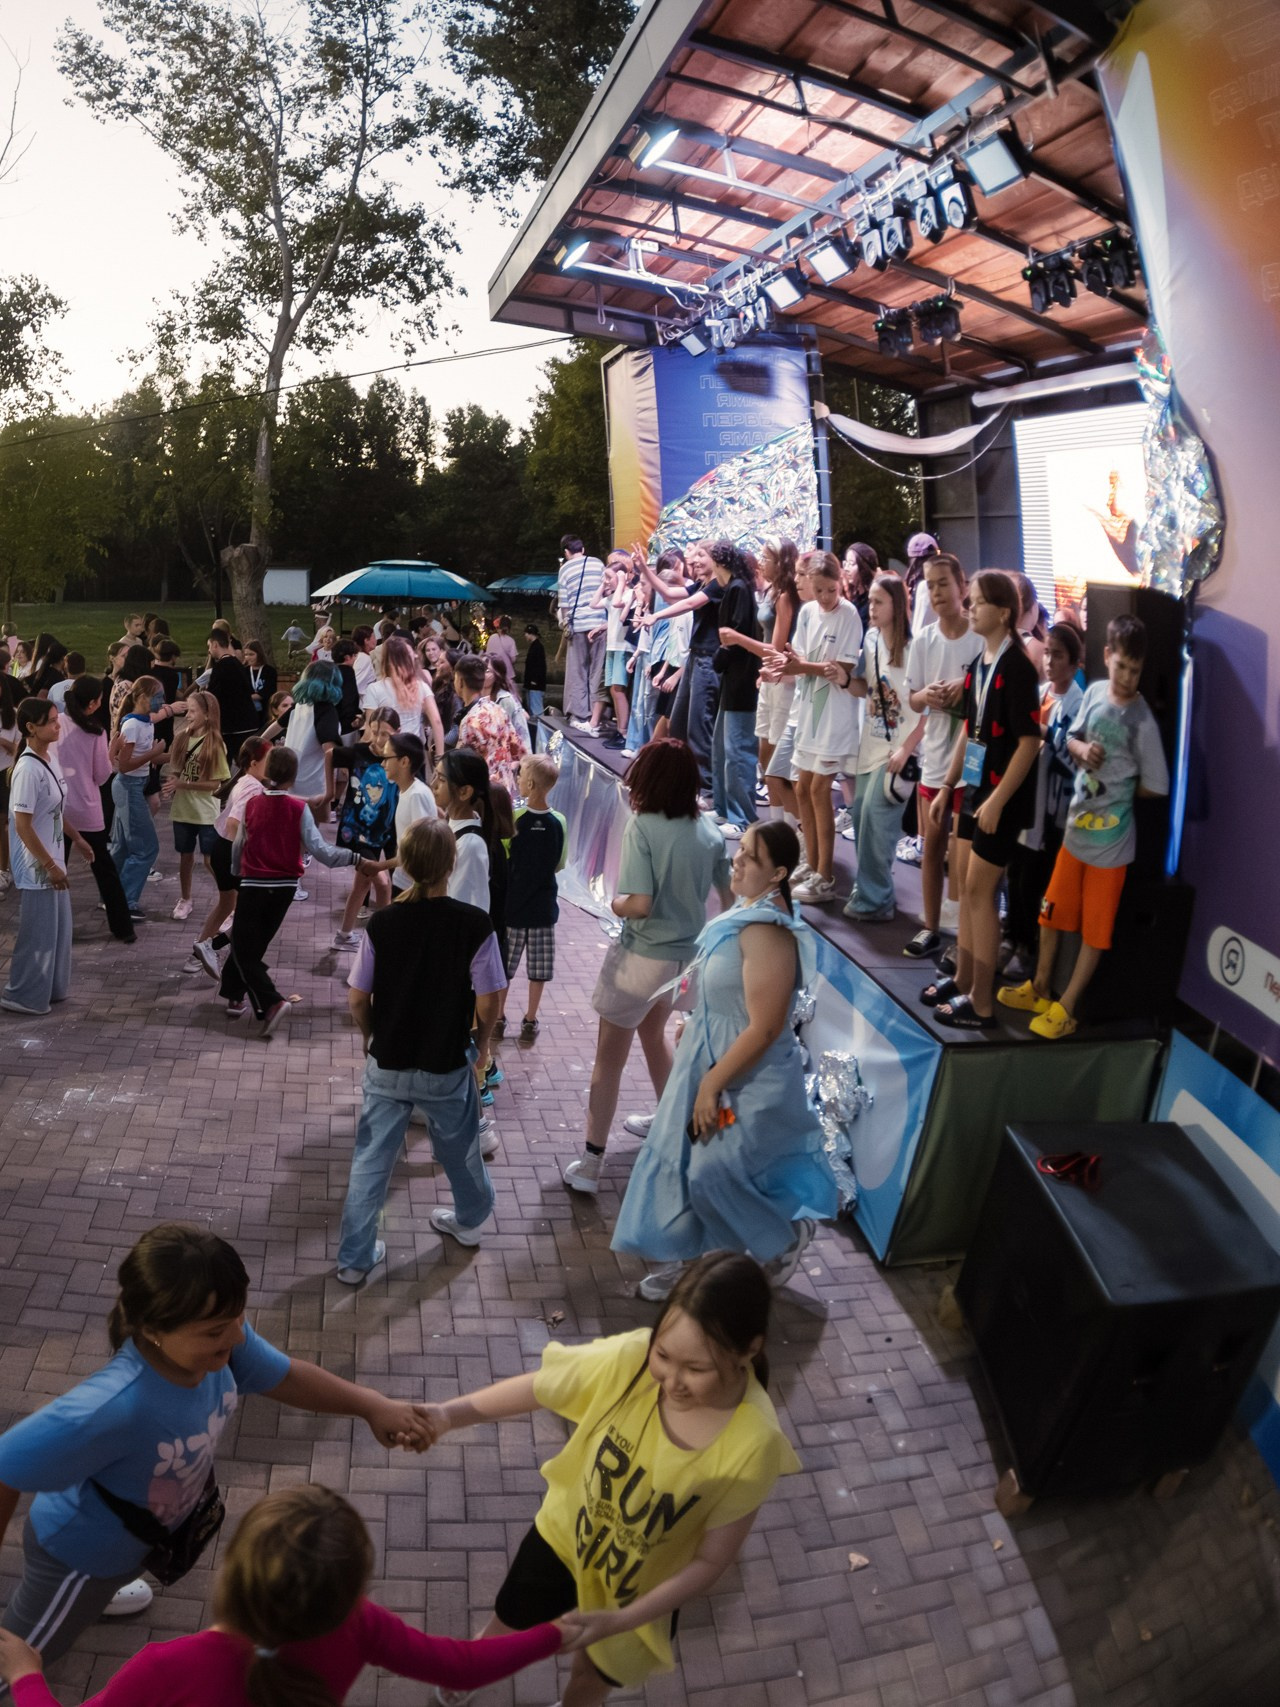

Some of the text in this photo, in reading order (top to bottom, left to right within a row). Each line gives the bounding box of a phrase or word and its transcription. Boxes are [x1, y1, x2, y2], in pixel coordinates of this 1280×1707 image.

[716, 392, 770, 408] ЯМА
[702, 412, 776, 428] ПЕРВЫ
[614, 1432, 635, 1454] YOU
[592, 1435, 701, 1538] RUN
[576, 1505, 645, 1600] GIRL
